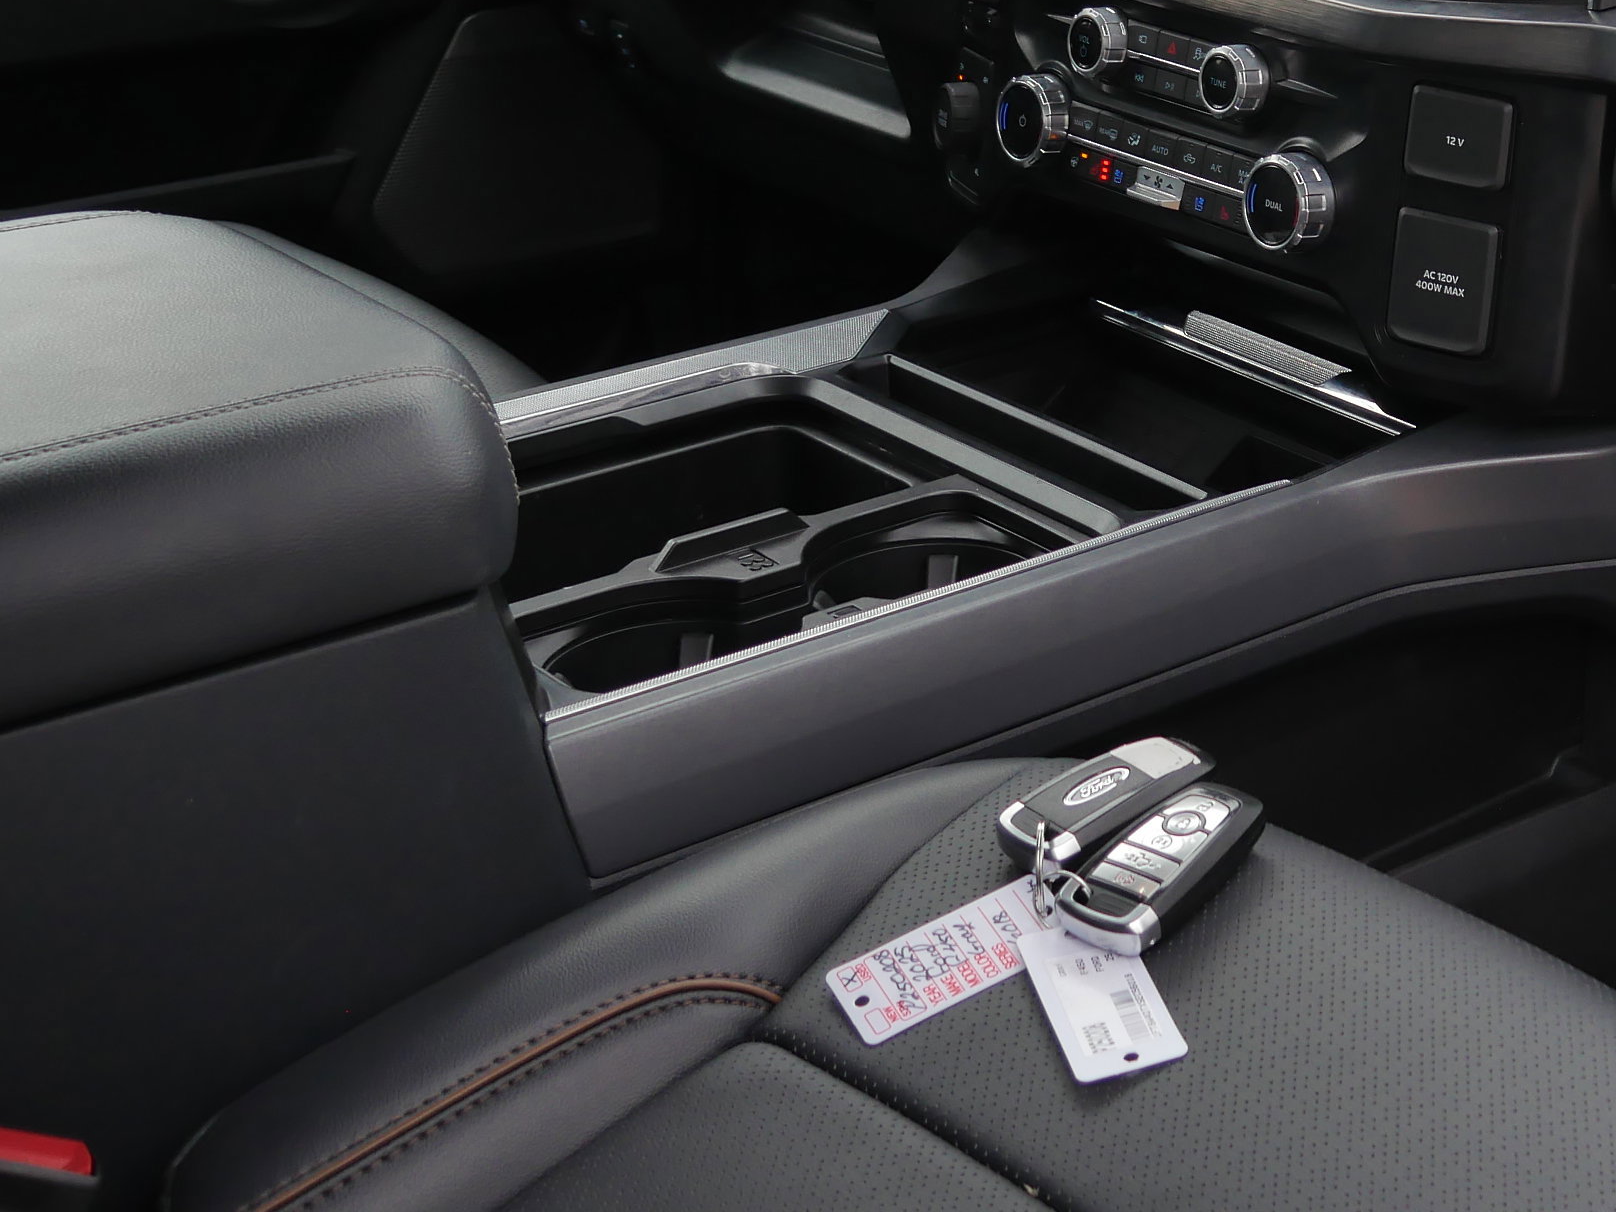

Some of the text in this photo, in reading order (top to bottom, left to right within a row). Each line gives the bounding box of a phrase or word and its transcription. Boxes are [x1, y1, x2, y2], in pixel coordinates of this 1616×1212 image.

[1210, 76, 1226, 90] TUNE
[1152, 144, 1169, 156] AUTO
[1446, 135, 1465, 147] 12 V
[1210, 164, 1222, 174] A/C
[1265, 198, 1283, 213] DUAL
[1423, 270, 1459, 284] AC 120V
[1416, 280, 1465, 298] 400W MAX
[894, 946, 932, 981] 2025
[992, 943, 1018, 969] SERIES
[855, 963, 872, 983] USED
[957, 960, 982, 987] MODEL
[974, 953, 999, 978] COLOR
[939, 975, 961, 996] MAKE
[923, 985, 944, 1006] YEAR
[883, 1007, 898, 1024] NEW
